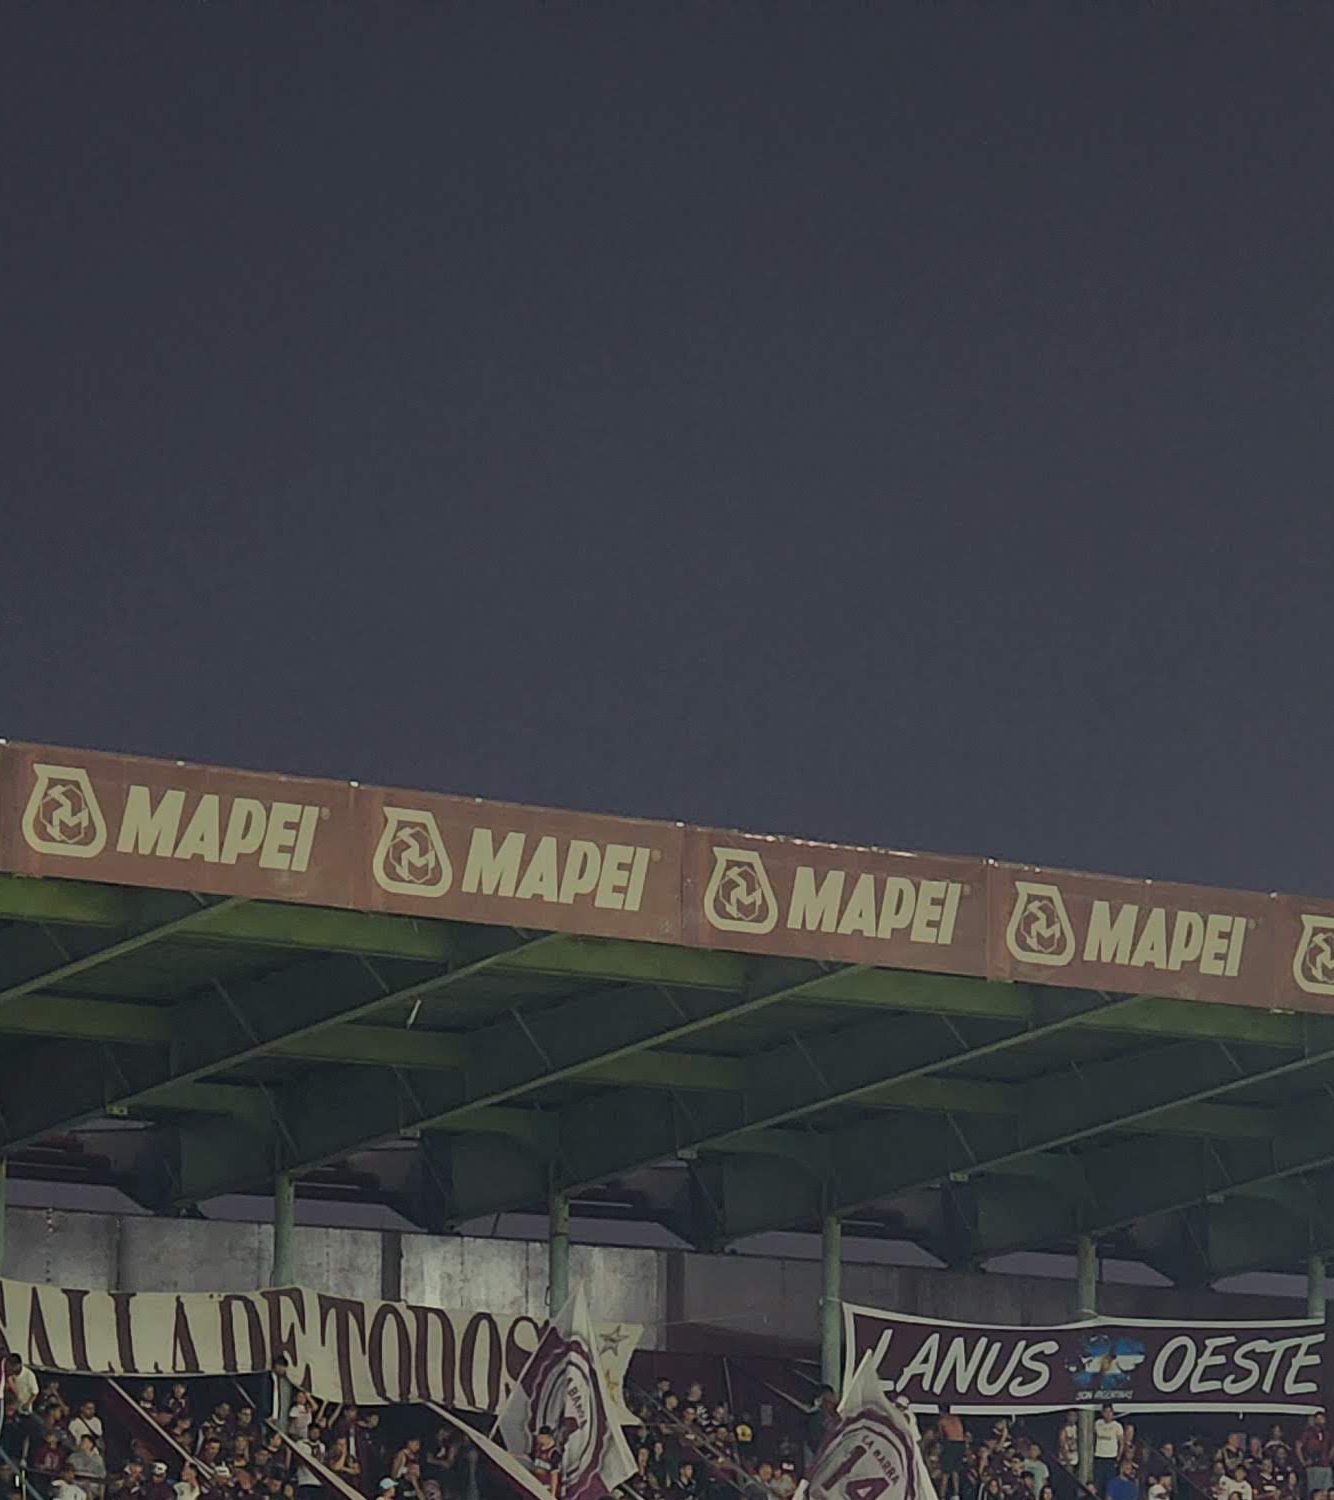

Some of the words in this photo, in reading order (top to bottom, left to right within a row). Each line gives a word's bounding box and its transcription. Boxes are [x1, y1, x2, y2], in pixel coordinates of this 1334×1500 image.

[117, 786, 319, 871] MAPEI
[462, 829, 651, 912] MAPEI
[787, 867, 962, 945] MAPEI
[1083, 900, 1247, 977] MAPEI
[219, 1286, 313, 1394] DE
[863, 1328, 1059, 1396] LANUS
[1152, 1333, 1326, 1395] OESTE
